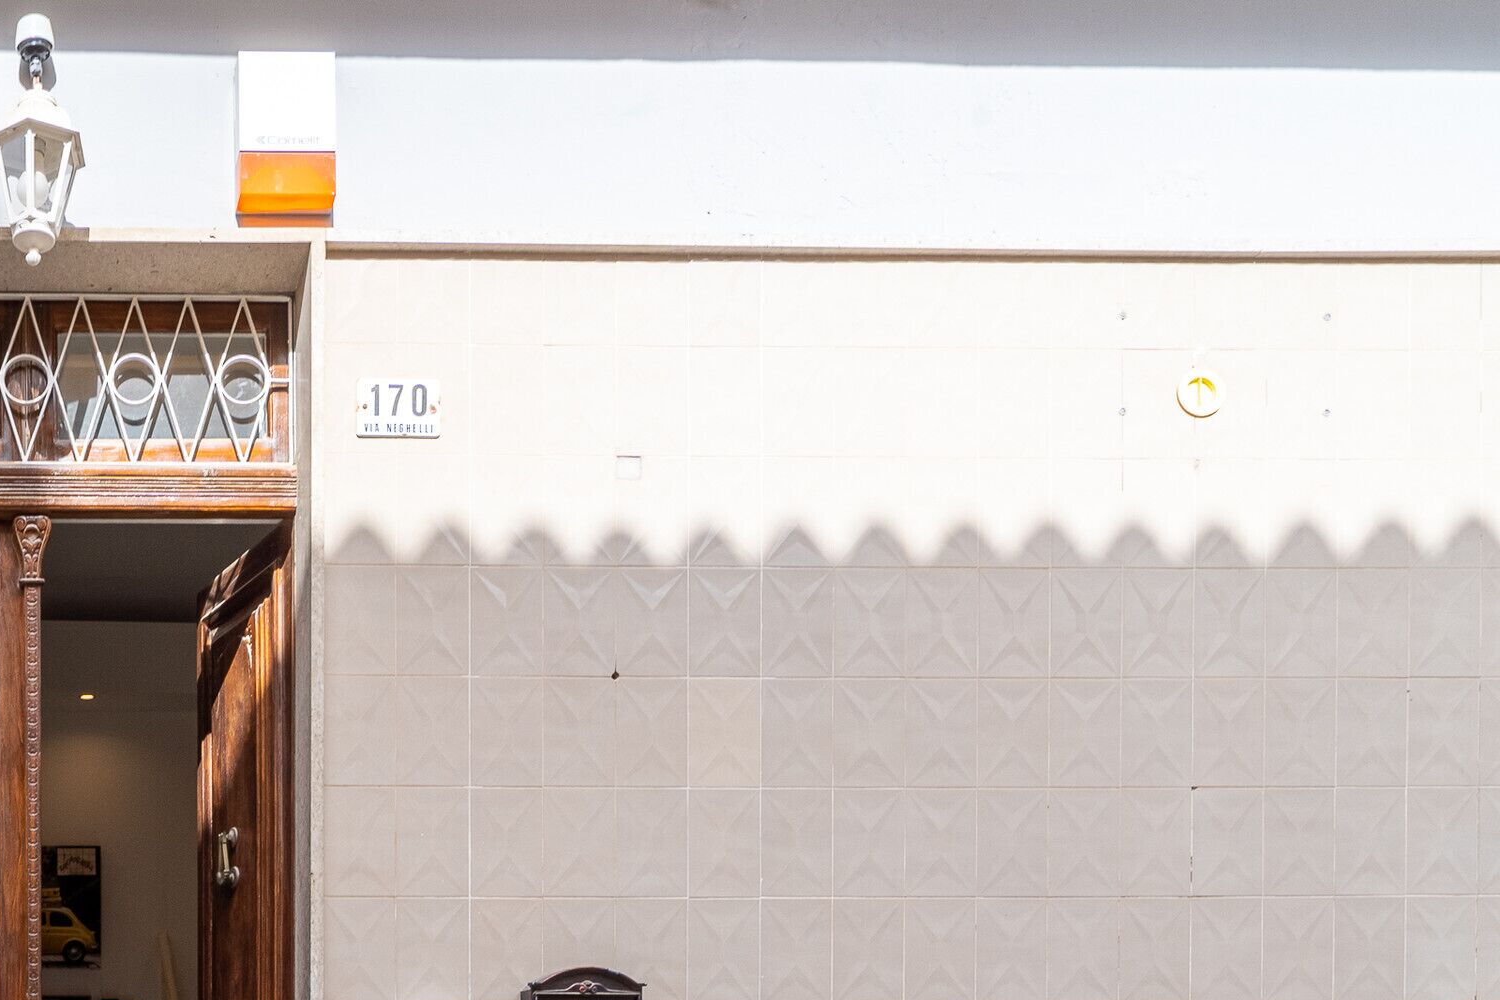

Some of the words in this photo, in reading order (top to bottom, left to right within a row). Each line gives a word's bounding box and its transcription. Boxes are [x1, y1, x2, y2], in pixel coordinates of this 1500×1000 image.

[371, 383, 428, 417] 170
[364, 423, 380, 433] VIA
[386, 423, 434, 433] NEGHELLI
